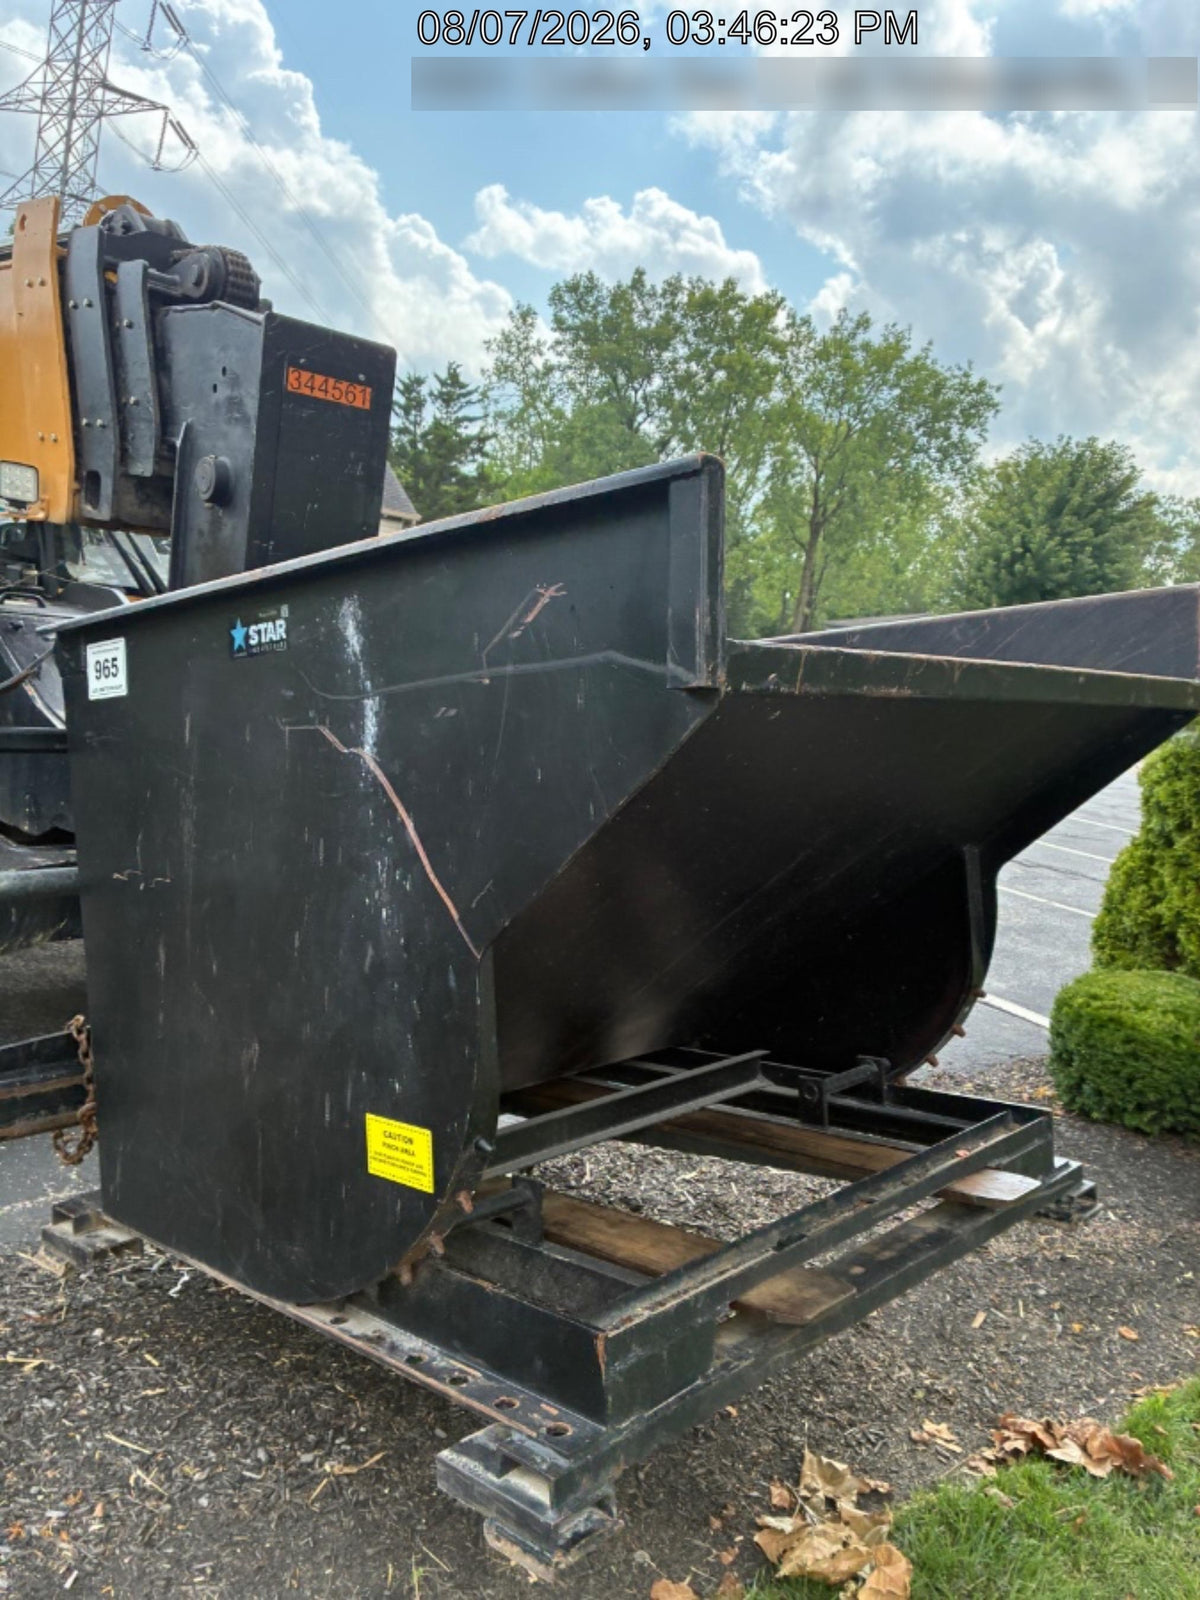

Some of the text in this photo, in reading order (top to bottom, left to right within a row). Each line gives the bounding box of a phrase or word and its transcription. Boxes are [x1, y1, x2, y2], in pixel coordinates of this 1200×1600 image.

[289, 369, 368, 406] 344561
[248, 618, 287, 646] STAR
[94, 657, 119, 680] 965
[383, 1130, 414, 1146] CAUTION
